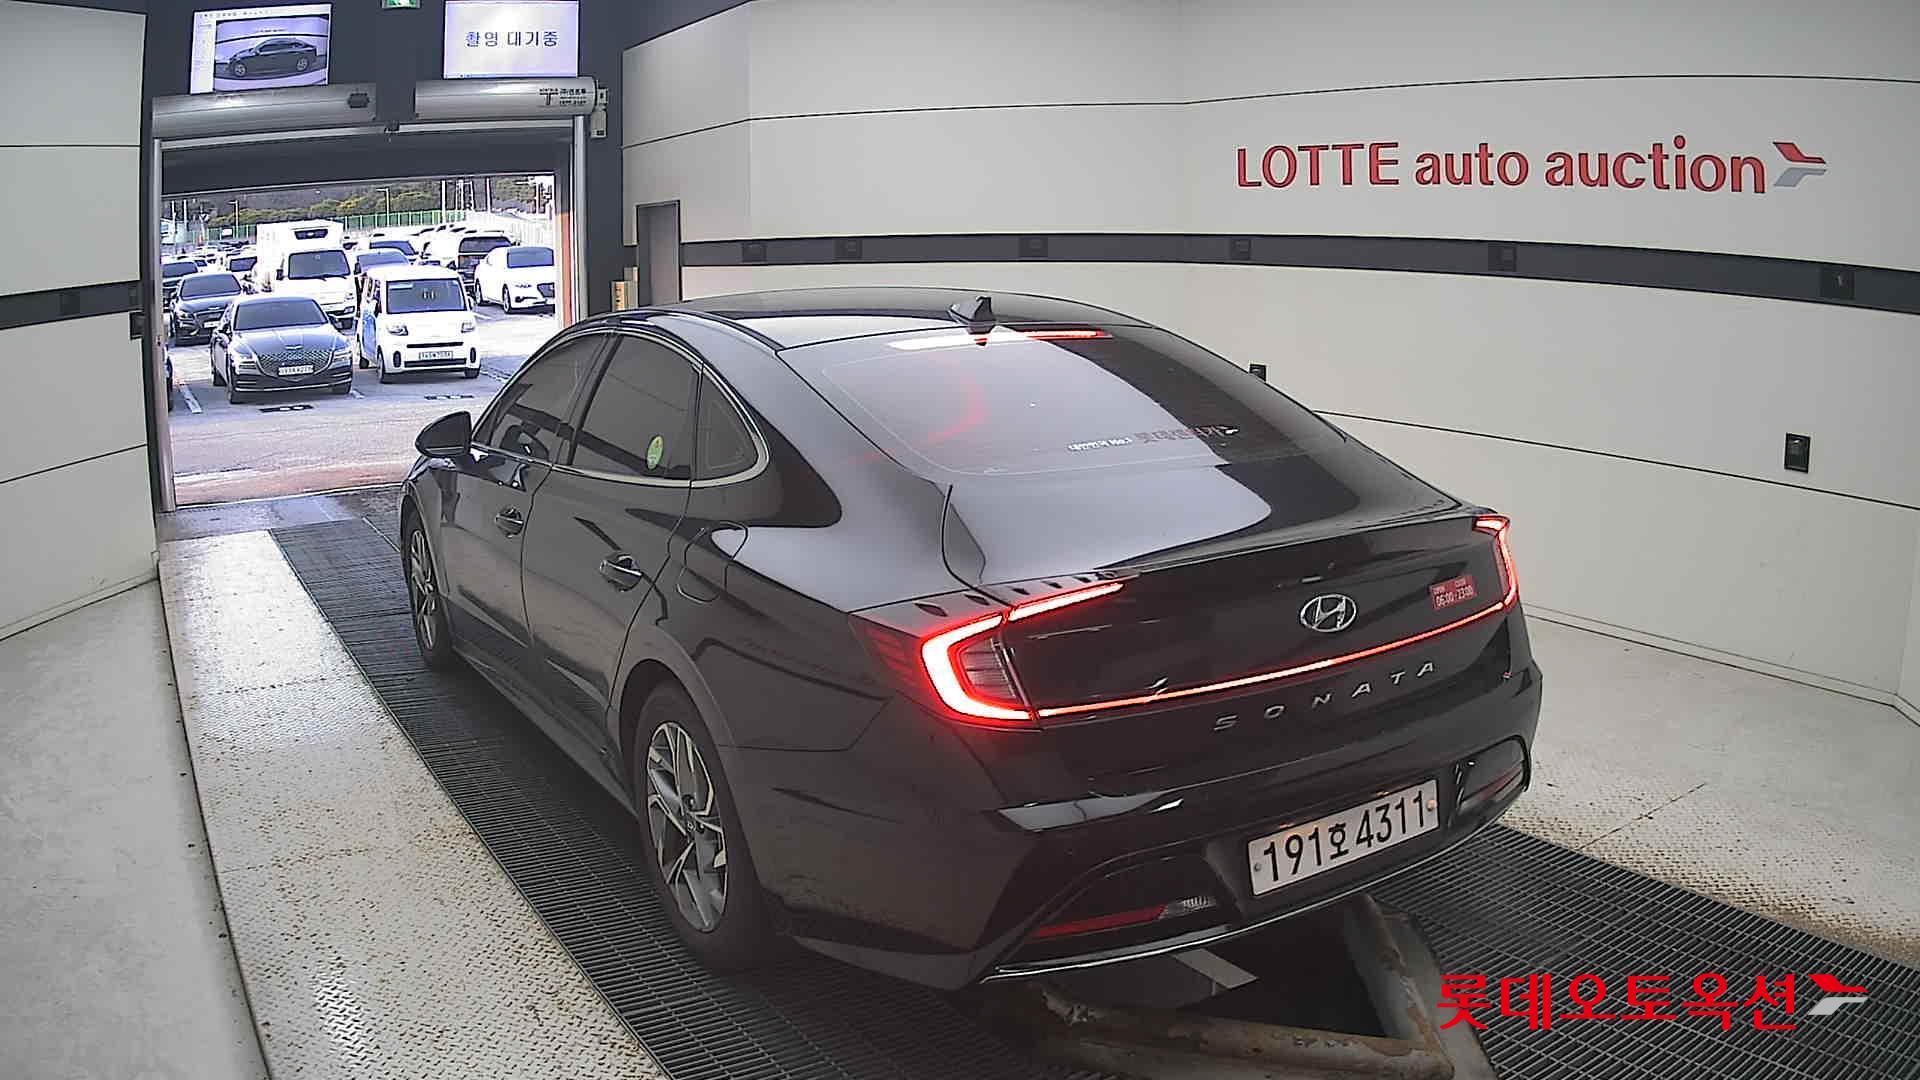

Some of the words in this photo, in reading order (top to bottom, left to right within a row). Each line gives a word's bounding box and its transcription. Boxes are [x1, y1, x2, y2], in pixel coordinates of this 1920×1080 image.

[465, 31, 498, 47] 촬영
[507, 31, 558, 47] 대기중
[1239, 143, 1397, 187] LOTTE
[1416, 144, 1529, 184] auto
[1545, 136, 1767, 193] auction
[1213, 661, 1435, 731] SONATA
